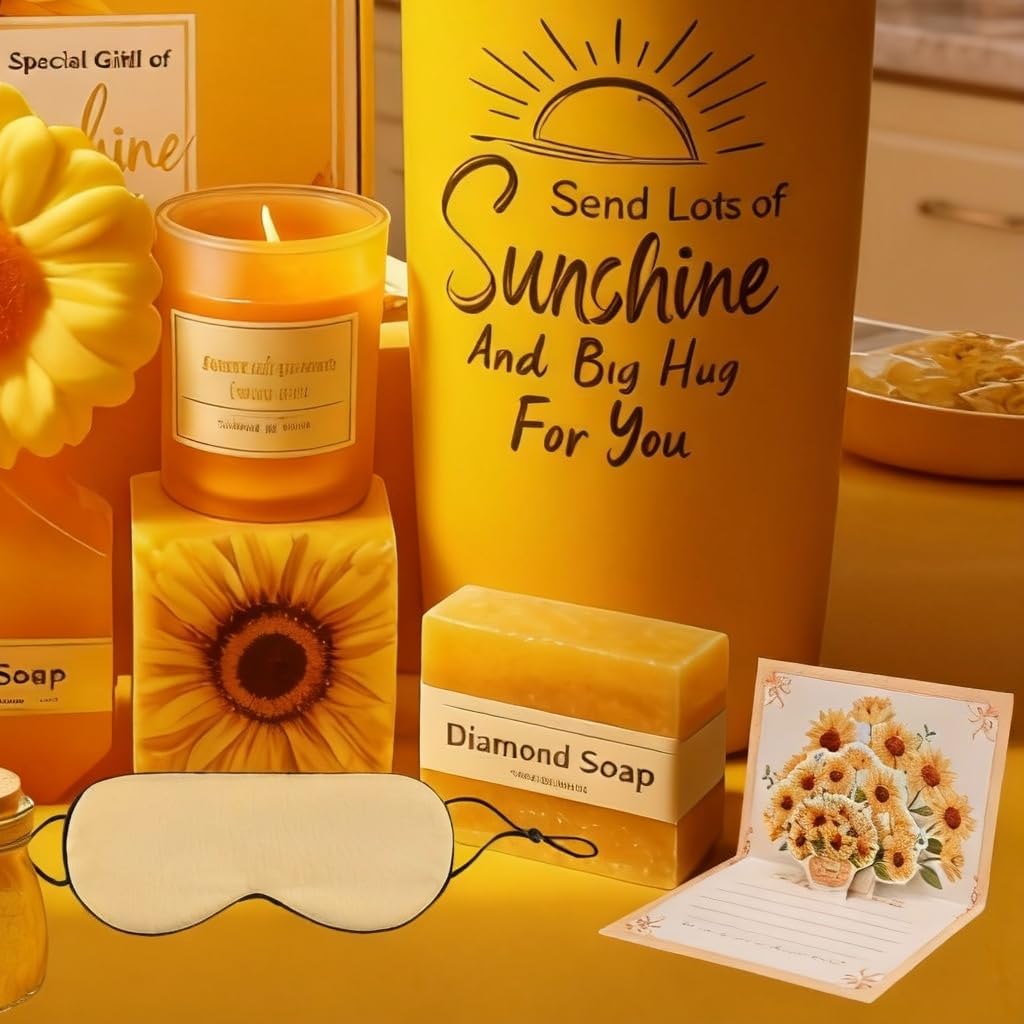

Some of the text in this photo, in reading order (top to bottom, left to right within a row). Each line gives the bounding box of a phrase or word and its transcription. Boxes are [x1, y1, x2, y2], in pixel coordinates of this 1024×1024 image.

[149, 49, 172, 69] of
[551, 179, 790, 221] Send Lots of
[467, 324, 740, 396] And Big Hug
[510, 395, 691, 467] For You
[446, 722, 570, 769] Diamond
[579, 750, 655, 794] Soap
